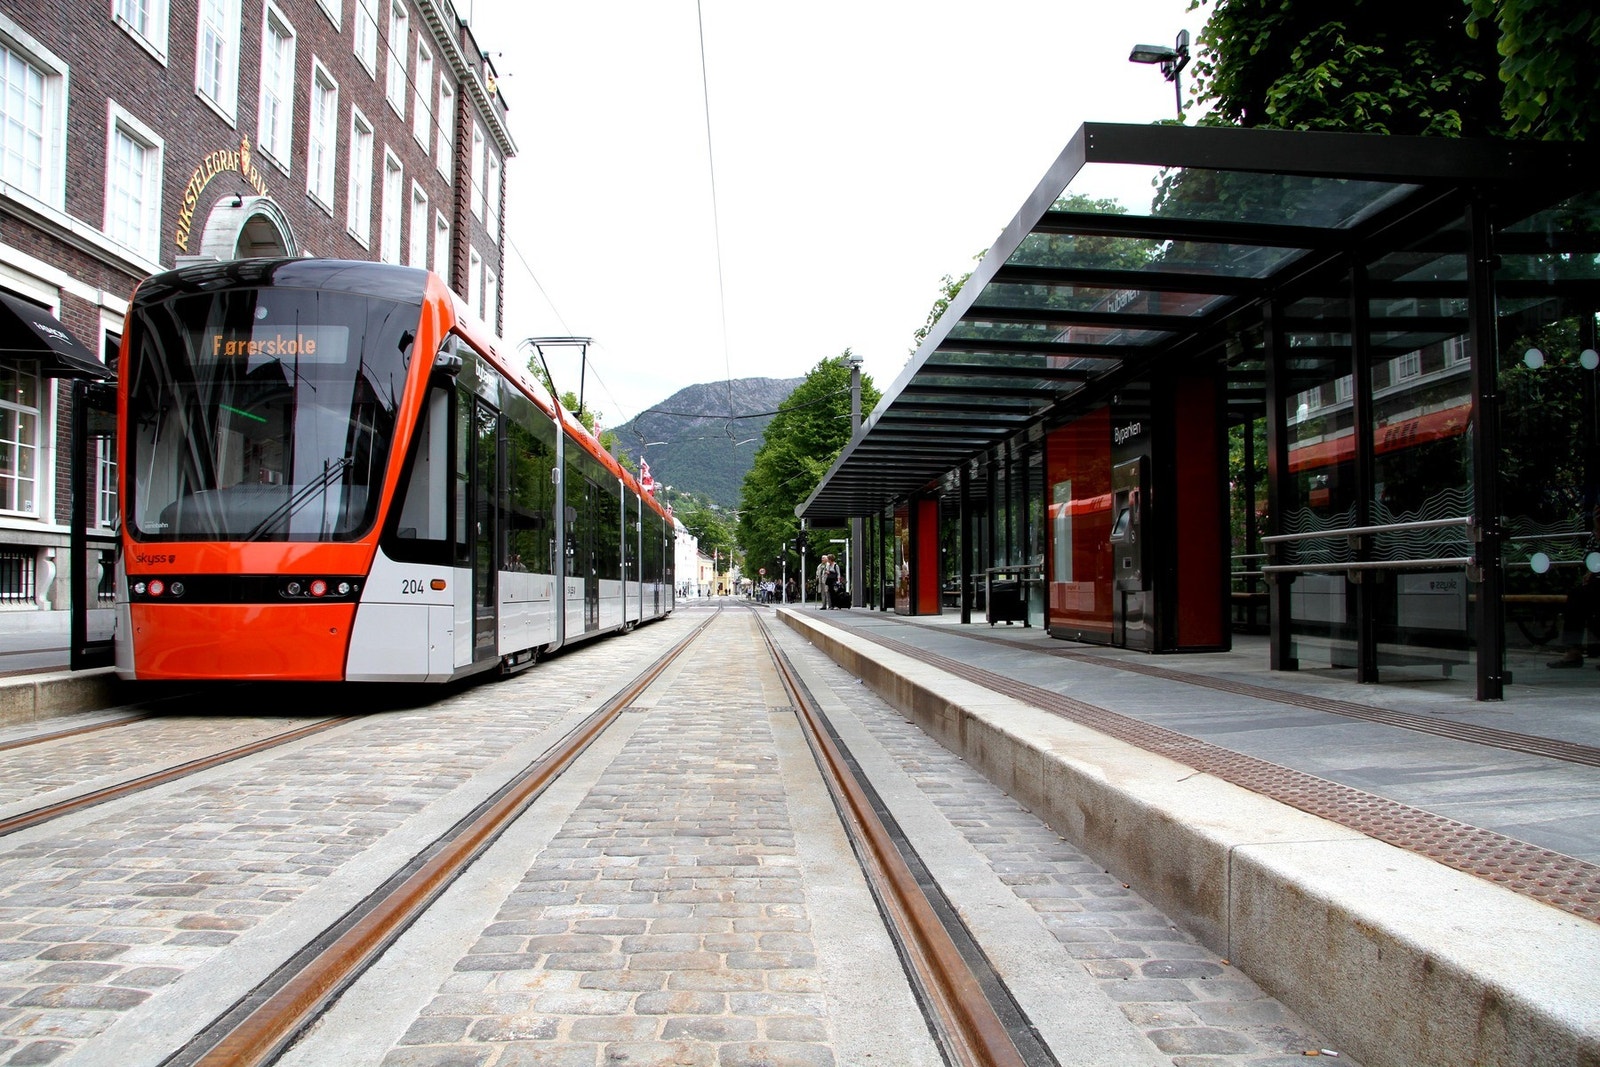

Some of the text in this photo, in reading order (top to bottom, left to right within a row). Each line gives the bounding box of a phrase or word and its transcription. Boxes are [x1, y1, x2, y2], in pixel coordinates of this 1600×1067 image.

[175, 149, 241, 252] RIKSTELEGRAF
[212, 333, 316, 356] Førerskole
[1114, 421, 1141, 445] Byparken
[136, 552, 166, 565] skyss
[402, 579, 424, 595] 204
